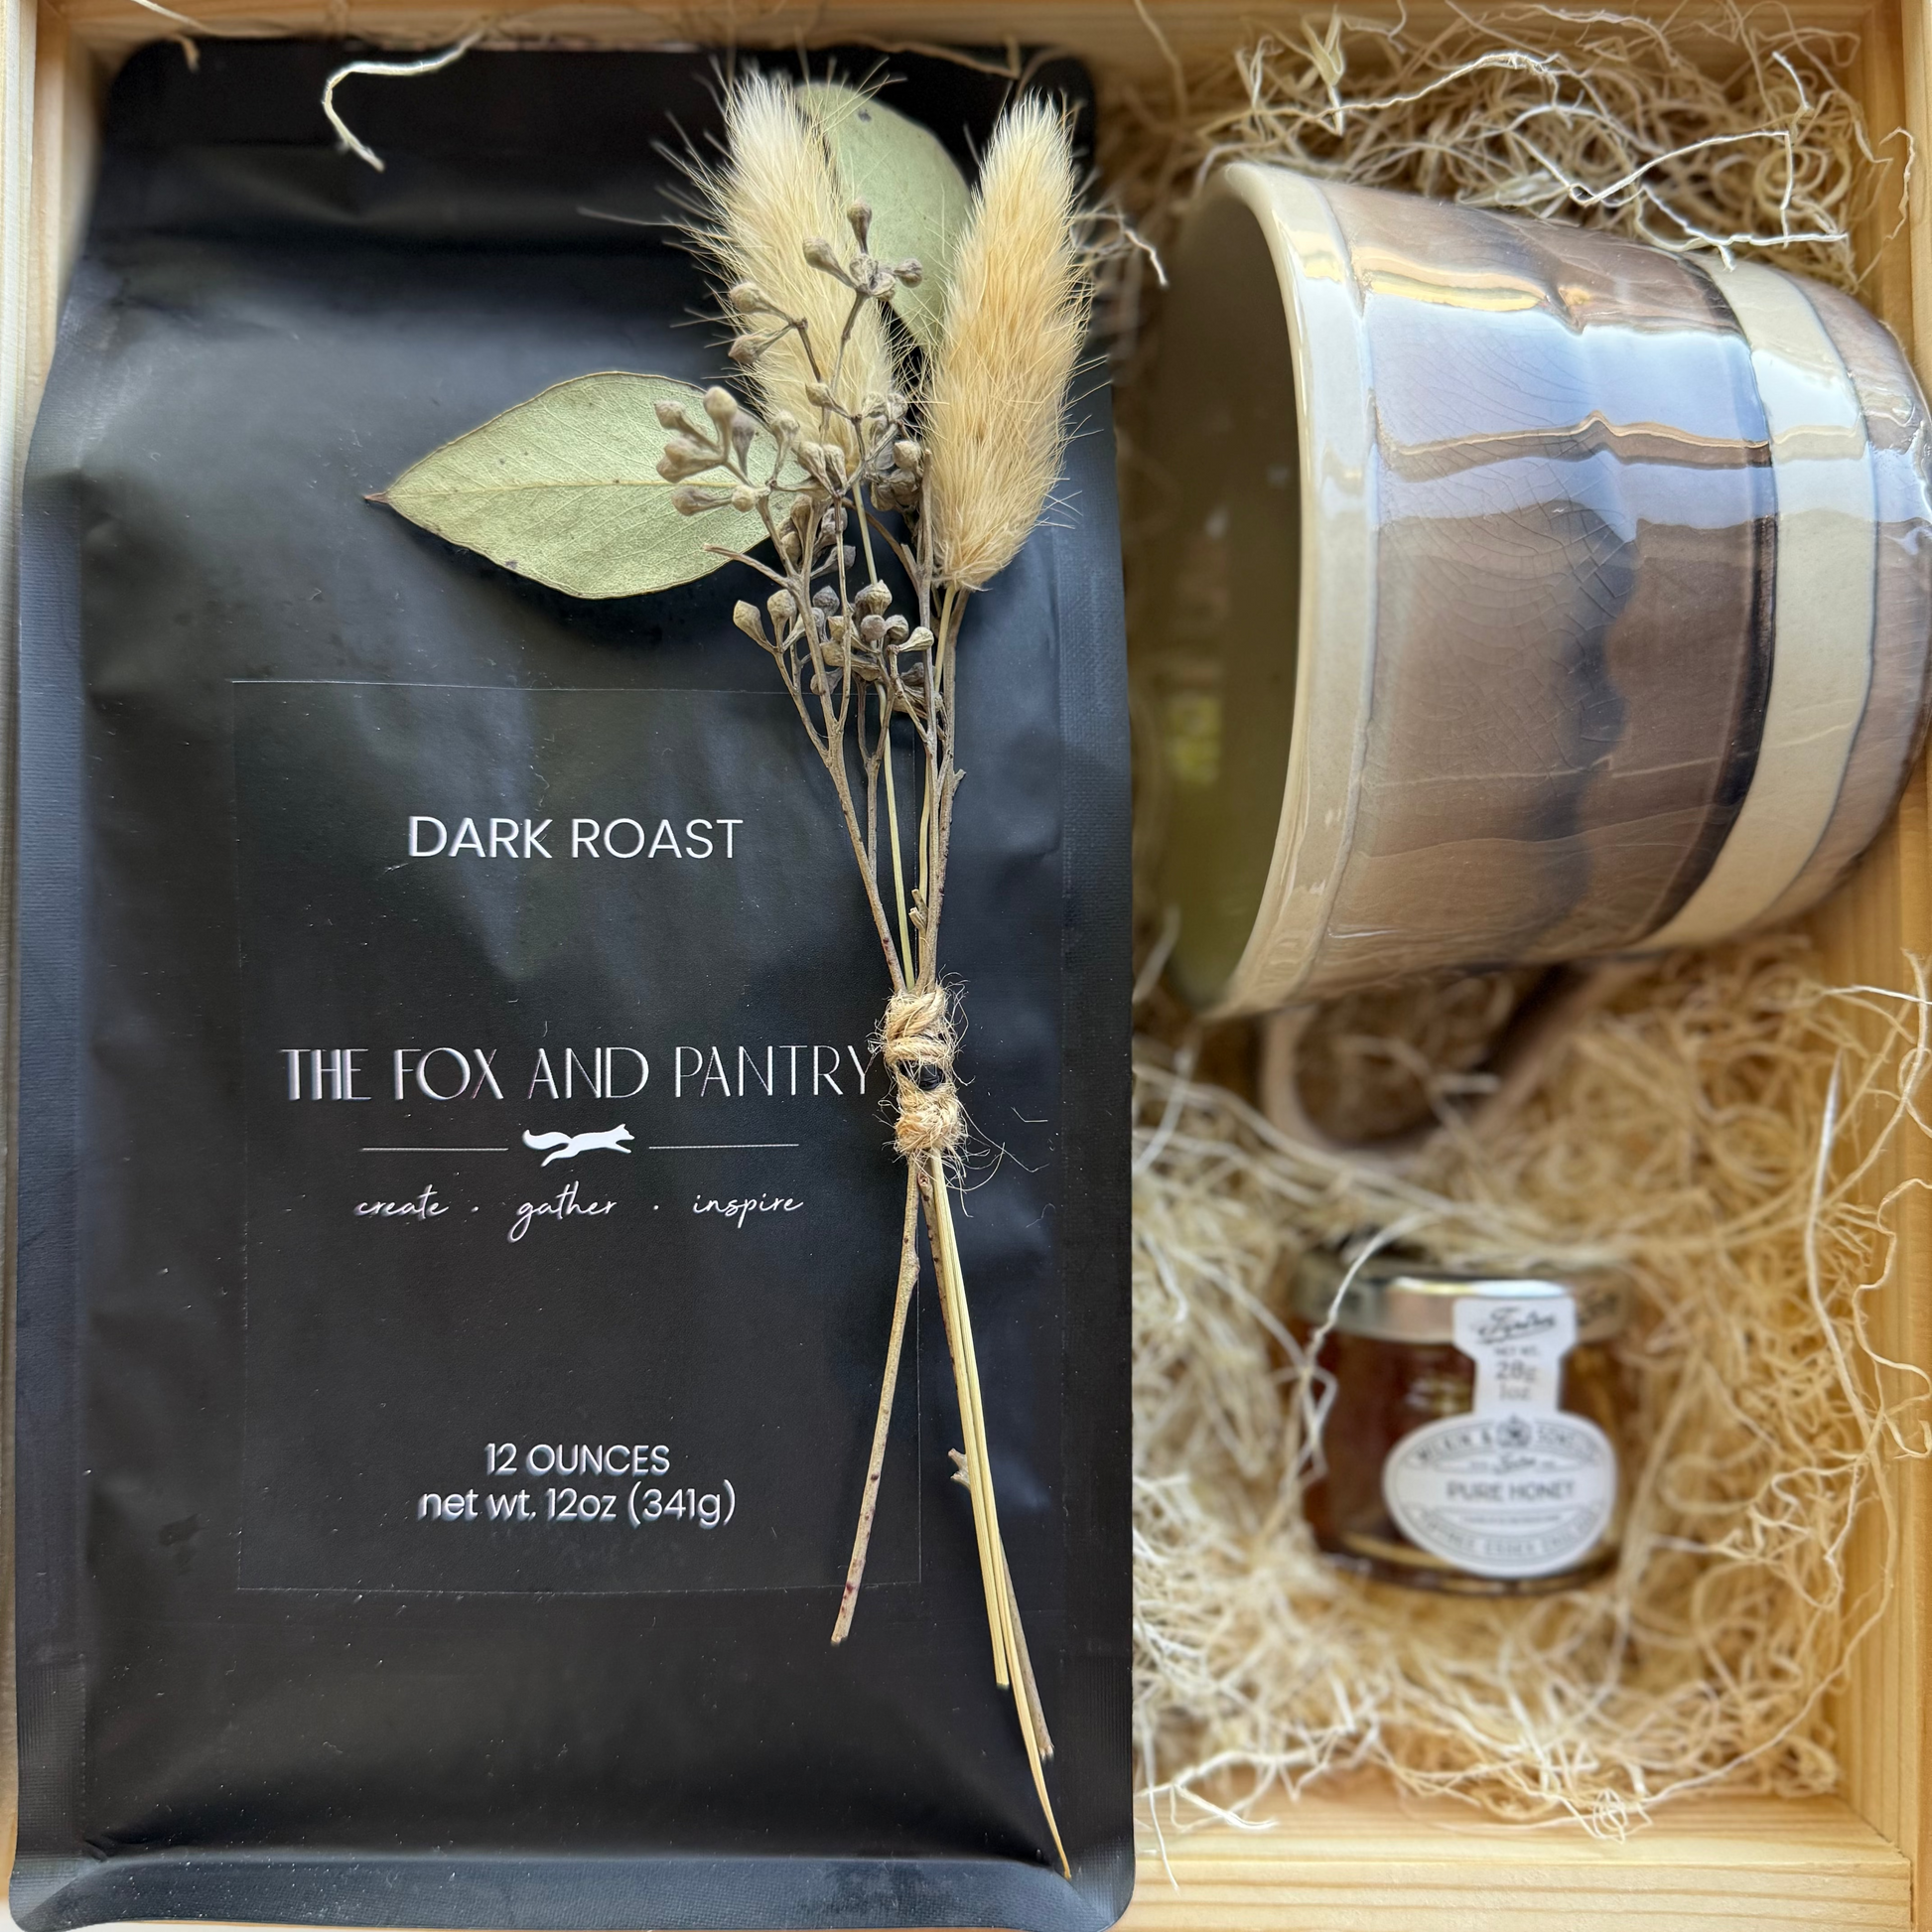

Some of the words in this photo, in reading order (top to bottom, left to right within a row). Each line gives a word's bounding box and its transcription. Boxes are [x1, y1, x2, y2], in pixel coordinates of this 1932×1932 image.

[408, 815, 553, 859] DARK
[571, 816, 745, 860] ROAST
[281, 1048, 371, 1101] THE
[394, 1046, 504, 1101] FOX
[527, 1046, 650, 1100] AND
[674, 1043, 875, 1098] PANTRY
[353, 1184, 450, 1220] create
[507, 1179, 618, 1243] gather
[692, 1192, 804, 1229] inspire
[484, 1443, 518, 1475] 12
[525, 1444, 670, 1477] OUNCES
[418, 1488, 479, 1521] net
[485, 1488, 537, 1521] wt.
[546, 1487, 618, 1522] 12oz
[627, 1478, 736, 1529] (341g)
[1445, 1480, 1504, 1502] PURE
[1508, 1479, 1575, 1501] HONEY
